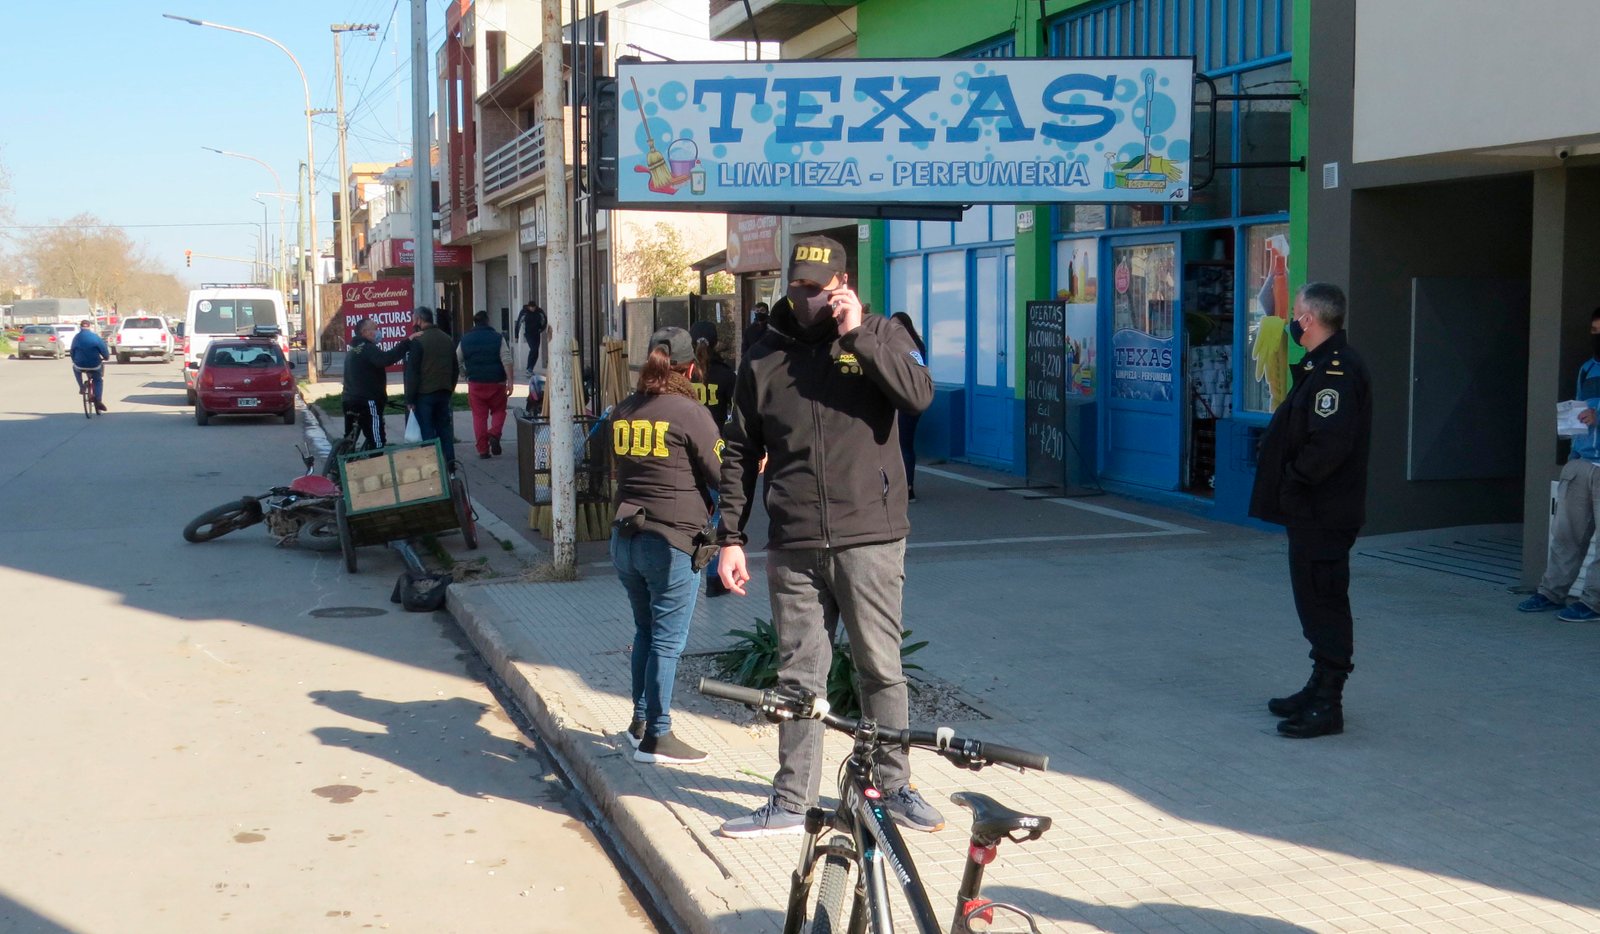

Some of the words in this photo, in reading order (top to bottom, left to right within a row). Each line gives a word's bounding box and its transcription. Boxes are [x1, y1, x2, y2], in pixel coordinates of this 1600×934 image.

[693, 73, 1118, 144] TEXAS
[718, 161, 863, 188] LIMPIEZA
[892, 160, 1091, 187] PERFUMERIA
[795, 246, 831, 264] DDI
[345, 287, 360, 302] La
[369, 311, 412, 326] FACTURAS
[1029, 304, 1064, 323] OFERTAS
[381, 325, 407, 339] FINAS
[1027, 331, 1056, 348] ALCOHOL
[1115, 347, 1172, 369] TEXAS
